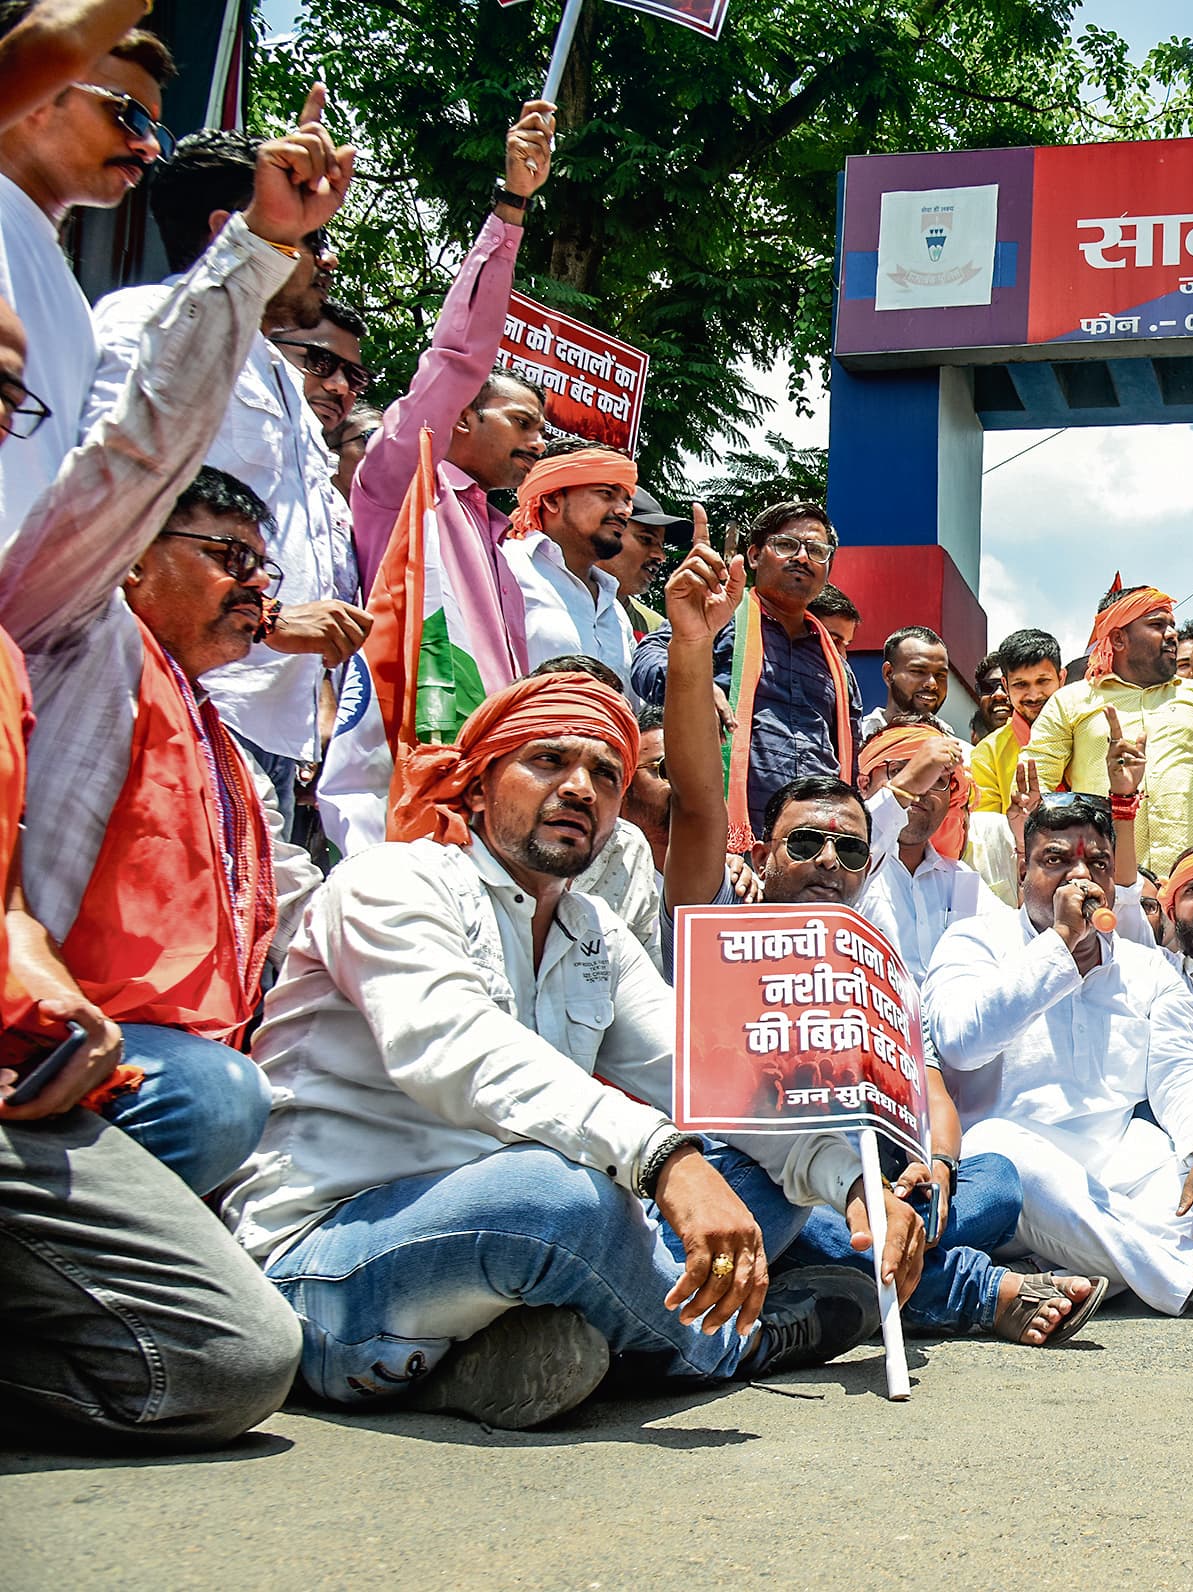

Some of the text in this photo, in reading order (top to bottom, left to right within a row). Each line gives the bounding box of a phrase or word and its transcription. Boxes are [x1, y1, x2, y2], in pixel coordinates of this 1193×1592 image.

[1080, 313, 1141, 336] फोन
[526, 324, 555, 355] को
[555, 336, 617, 381] दलालों
[615, 363, 638, 392] का
[570, 374, 597, 407] बंद
[597, 387, 632, 422] करो
[720, 919, 829, 962] साकची
[835, 928, 885, 980] थाना
[745, 1009, 793, 1054] की
[796, 1009, 870, 1052] बिक्री
[870, 1023, 898, 1070] बंद
[785, 1088, 830, 1105] जन
[834, 1081, 898, 1115] सुविधा
